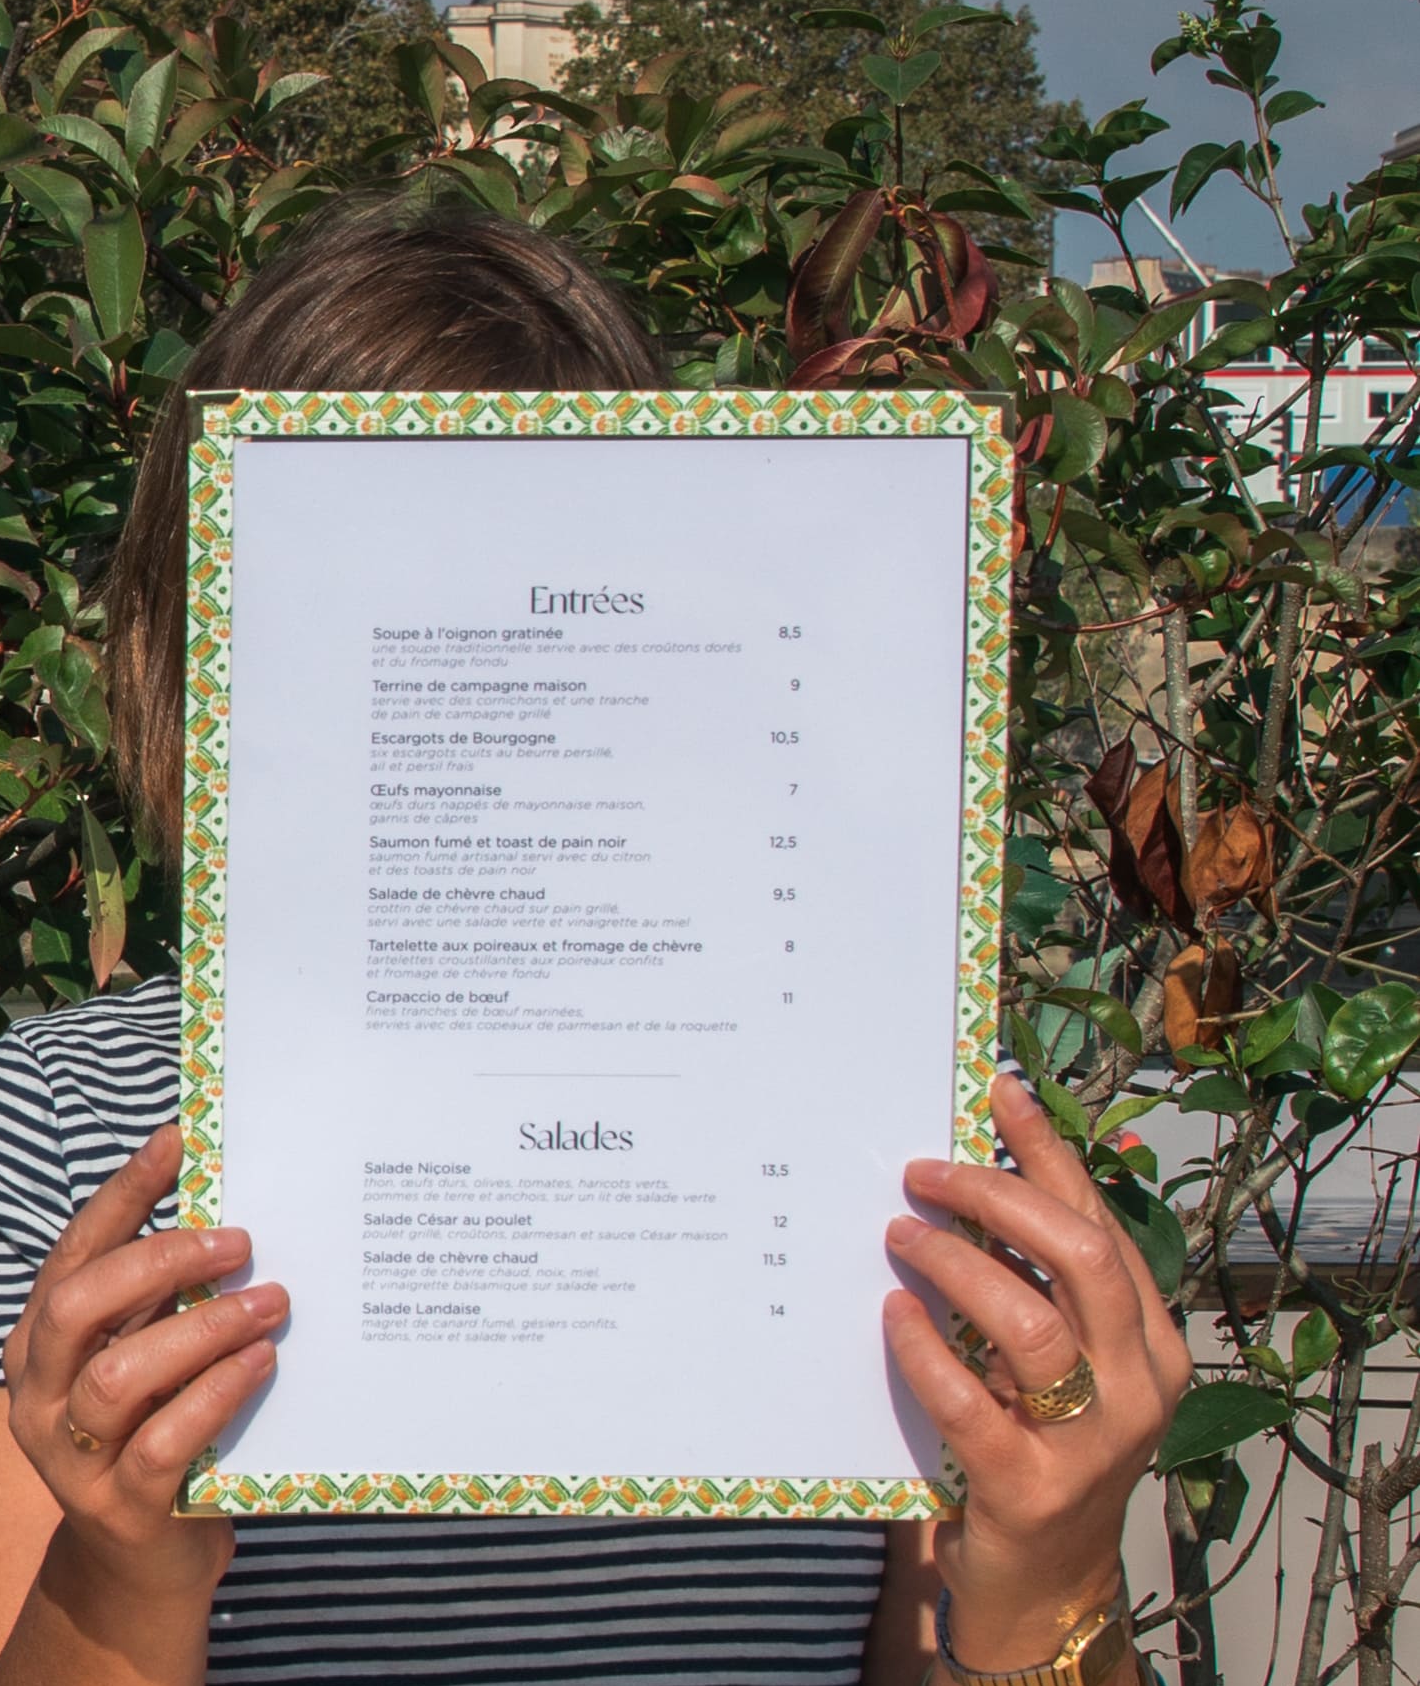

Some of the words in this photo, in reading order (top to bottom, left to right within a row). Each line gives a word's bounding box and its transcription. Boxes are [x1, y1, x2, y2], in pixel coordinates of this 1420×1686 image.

[530, 585, 645, 615] Entrées
[372, 627, 421, 642] Soupe
[424, 627, 433, 640] à
[501, 627, 564, 642] gratinée
[778, 625, 802, 640] 8,5
[371, 645, 396, 654] une
[401, 645, 441, 654] soupe
[445, 643, 532, 654] traditionnelle
[536, 644, 576, 654] servie
[579, 644, 611, 654] avec
[613, 642, 639, 654] des
[641, 642, 701, 654] croûtons
[704, 642, 743, 654] dorés
[371, 657, 386, 668] et
[388, 657, 407, 667] du
[410, 656, 466, 669] fromage
[469, 656, 509, 667] fondu
[371, 731, 445, 747] Escargots
[449, 731, 468, 744] de
[473, 731, 556, 747] Bourgogne
[770, 731, 800, 746] 10,5
[370, 783, 410, 797] Œufs
[413, 784, 502, 799] mayonnaise
[789, 783, 799, 796] 7
[369, 835, 430, 849] Saumon
[434, 835, 472, 848] fumé
[476, 836, 491, 848] et
[496, 836, 534, 849] toast
[537, 835, 558, 849] de
[561, 836, 594, 850] pain
[597, 836, 628, 849] noir
[769, 835, 797, 850] 12,5
[367, 938, 438, 952] Tartelette
[442, 941, 469, 952] aux
[473, 939, 538, 953] poireaux
[542, 940, 557, 952] et
[562, 939, 625, 955] fromage
[628, 939, 649, 952] de
[652, 939, 703, 953] chèvre
[784, 940, 795, 953] 8
[519, 1120, 634, 1151] Salades
[364, 1161, 414, 1174] Salade
[418, 1162, 472, 1176] Niçoise
[761, 1163, 789, 1178] 13,5
[363, 1250, 412, 1264] Salade
[416, 1251, 435, 1264] de
[439, 1251, 489, 1264] chèvre
[492, 1251, 538, 1264] chaud
[763, 1253, 787, 1267] 11,5
